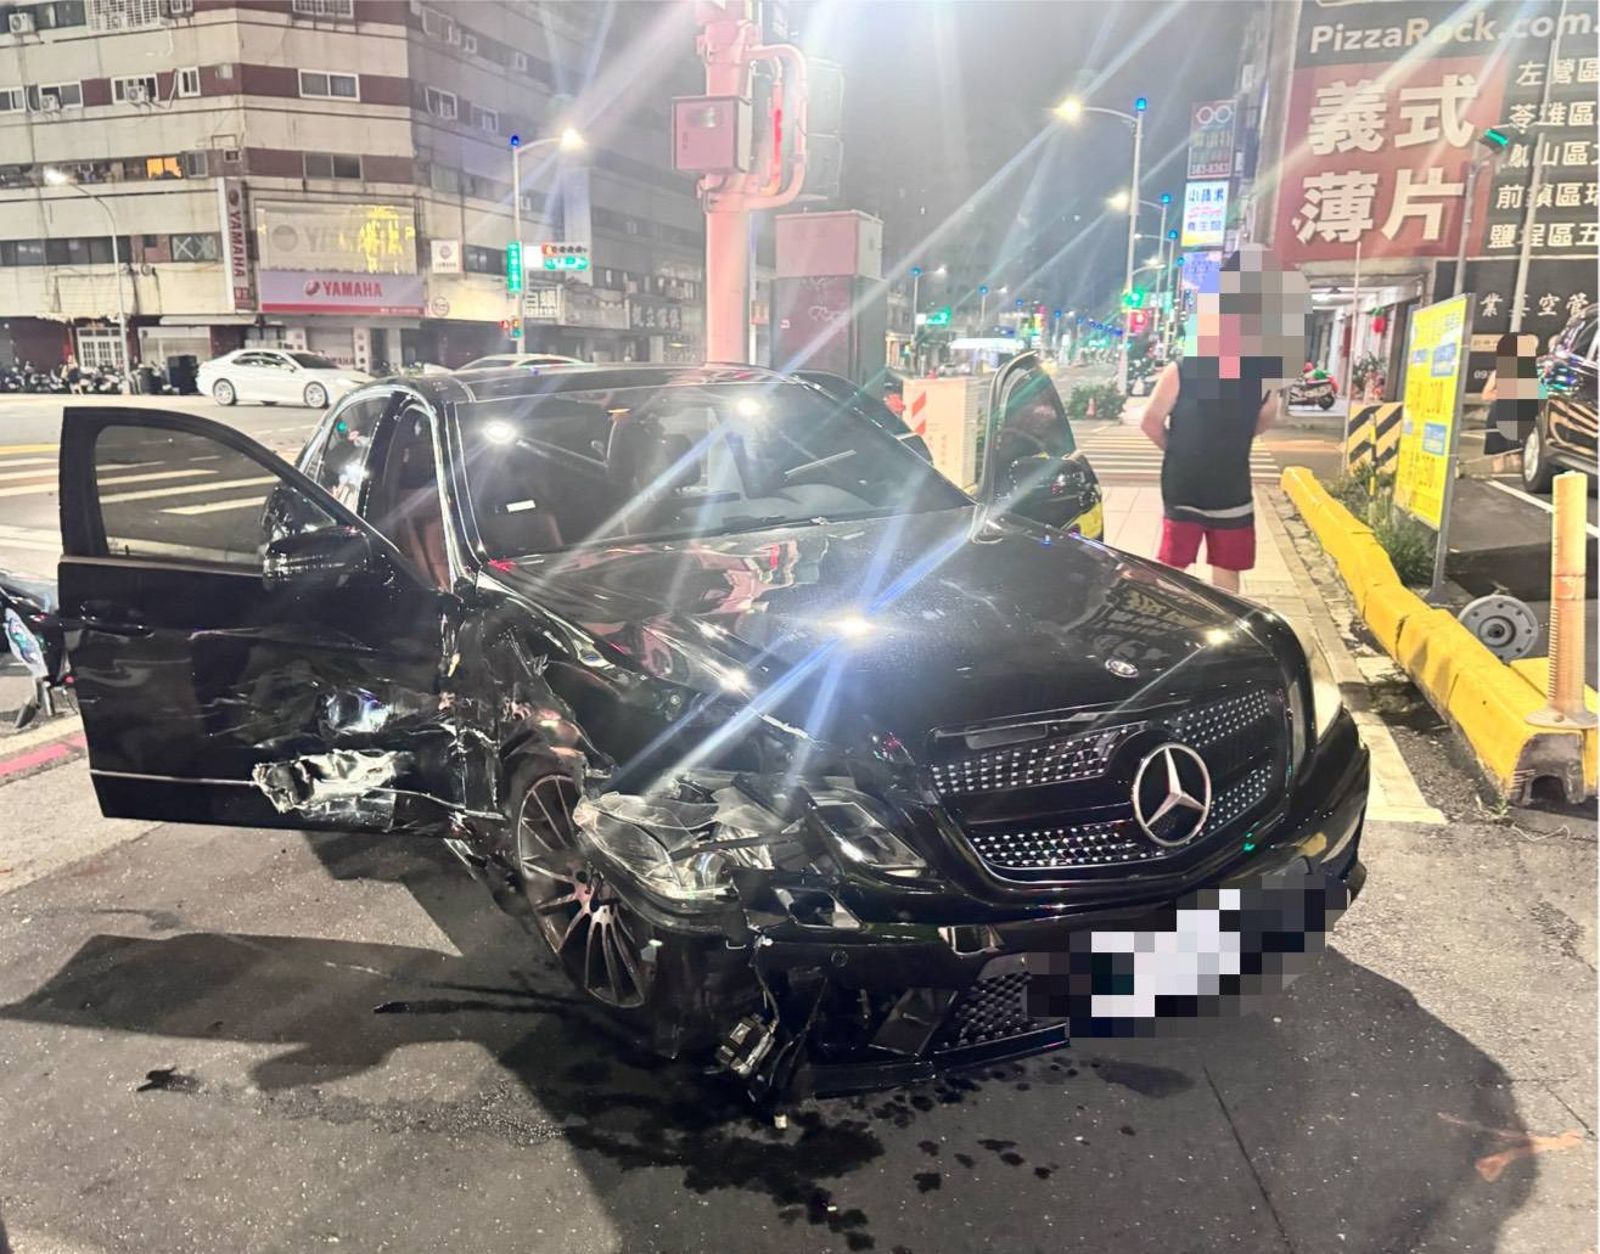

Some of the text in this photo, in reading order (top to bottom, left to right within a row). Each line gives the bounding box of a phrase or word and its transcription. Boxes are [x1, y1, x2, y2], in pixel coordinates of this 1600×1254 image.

[1307, 74, 1477, 157] 義式
[1292, 167, 1463, 244] 薄片
[229, 209, 246, 278] YAMAHA
[322, 281, 383, 298] YAMAHA
